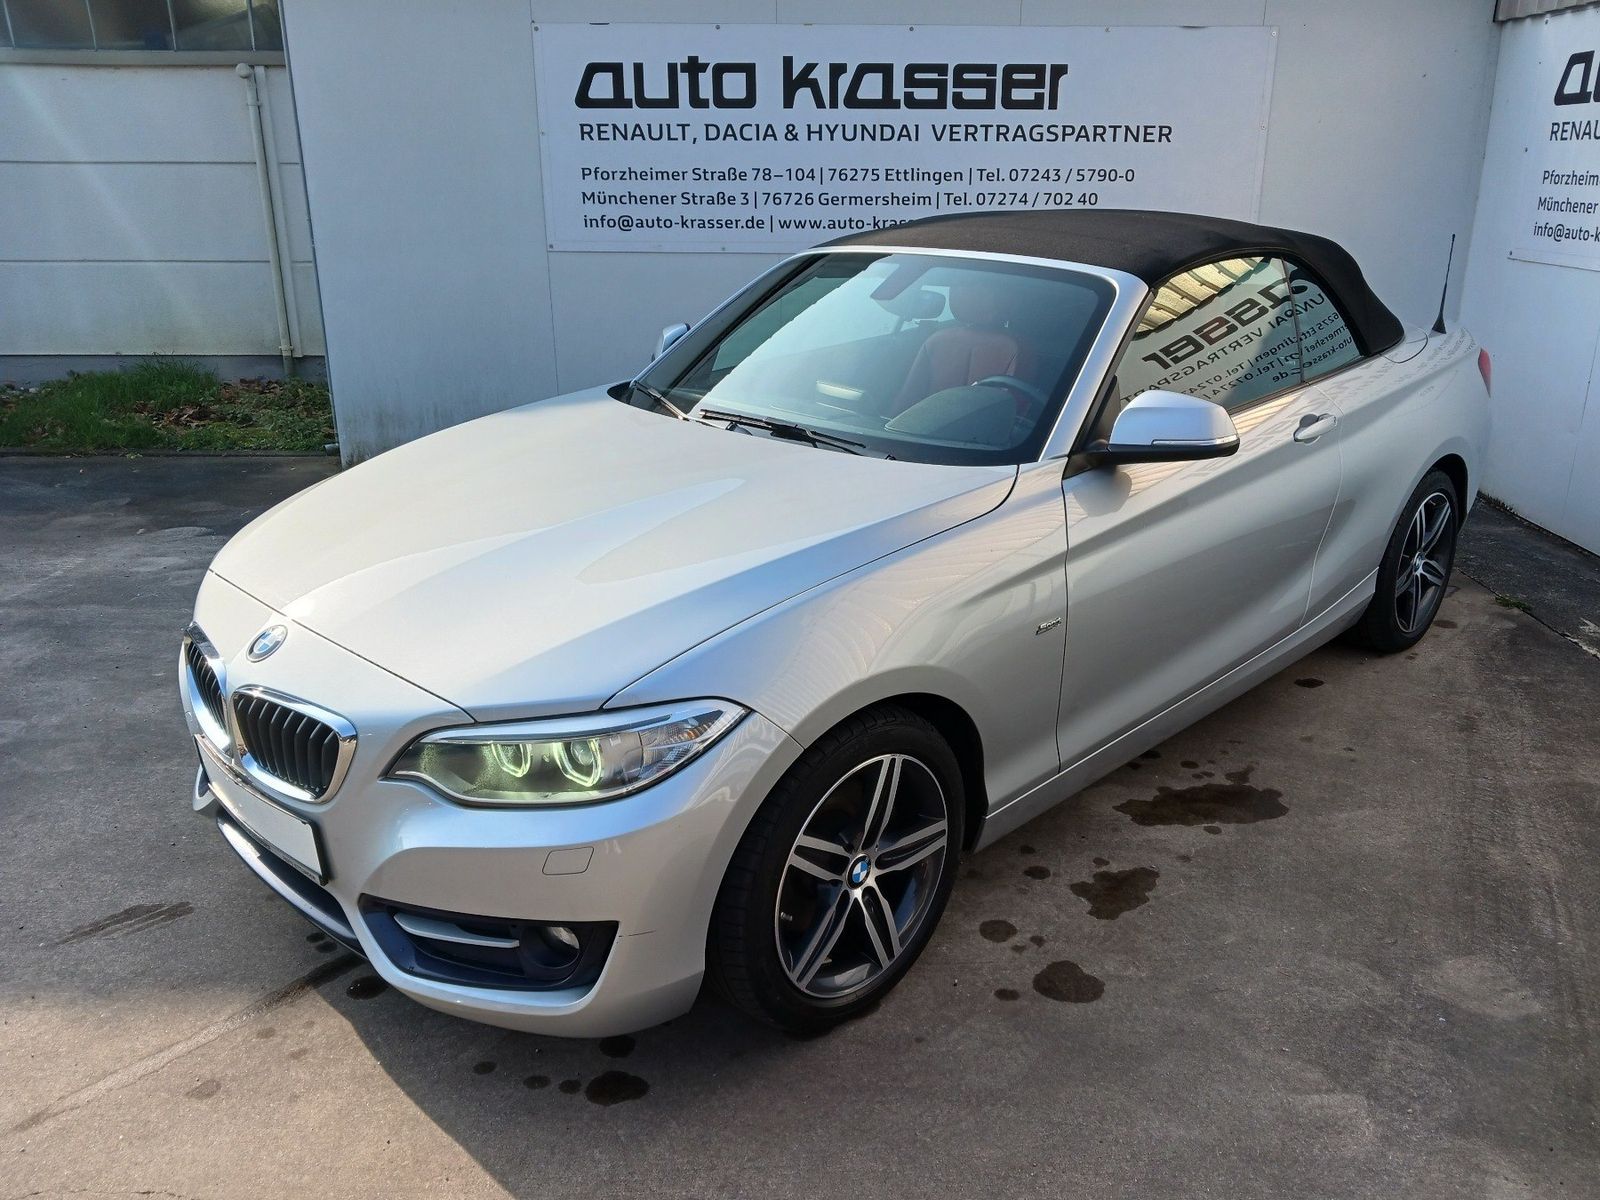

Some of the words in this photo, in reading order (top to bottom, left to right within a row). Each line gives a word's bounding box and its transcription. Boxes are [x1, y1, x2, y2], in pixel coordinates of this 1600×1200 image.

[574, 56, 757, 109] auto
[782, 56, 1069, 110] krasser
[579, 123, 697, 145] RENAULT,
[704, 123, 778, 141] DACIA
[784, 123, 799, 141] &
[806, 124, 919, 142] HYUNDAI
[931, 124, 1173, 143] VERTRAGSPARTNER
[581, 167, 688, 185] Pforzheimer
[692, 167, 748, 185] Straße
[828, 168, 880, 182] 76275
[885, 168, 964, 185] Ettlingen
[977, 168, 1006, 182] Tel.
[1009, 168, 1062, 182] 07243
[1076, 168, 1135, 182] 5790-0
[581, 191, 678, 206] Münchener
[681, 191, 737, 206] Straße
[740, 192, 750, 206] 3
[762, 192, 815, 206] 76726
[818, 191, 932, 207] Germersheim
[944, 192, 973, 206] Tel.
[976, 192, 1029, 206] 07274
[1044, 193, 1073, 206] 702
[1077, 193, 1098, 206] 40
[1537, 196, 1599, 214] Münchener
[584, 214, 765, 232] info@auto-krasser.de
